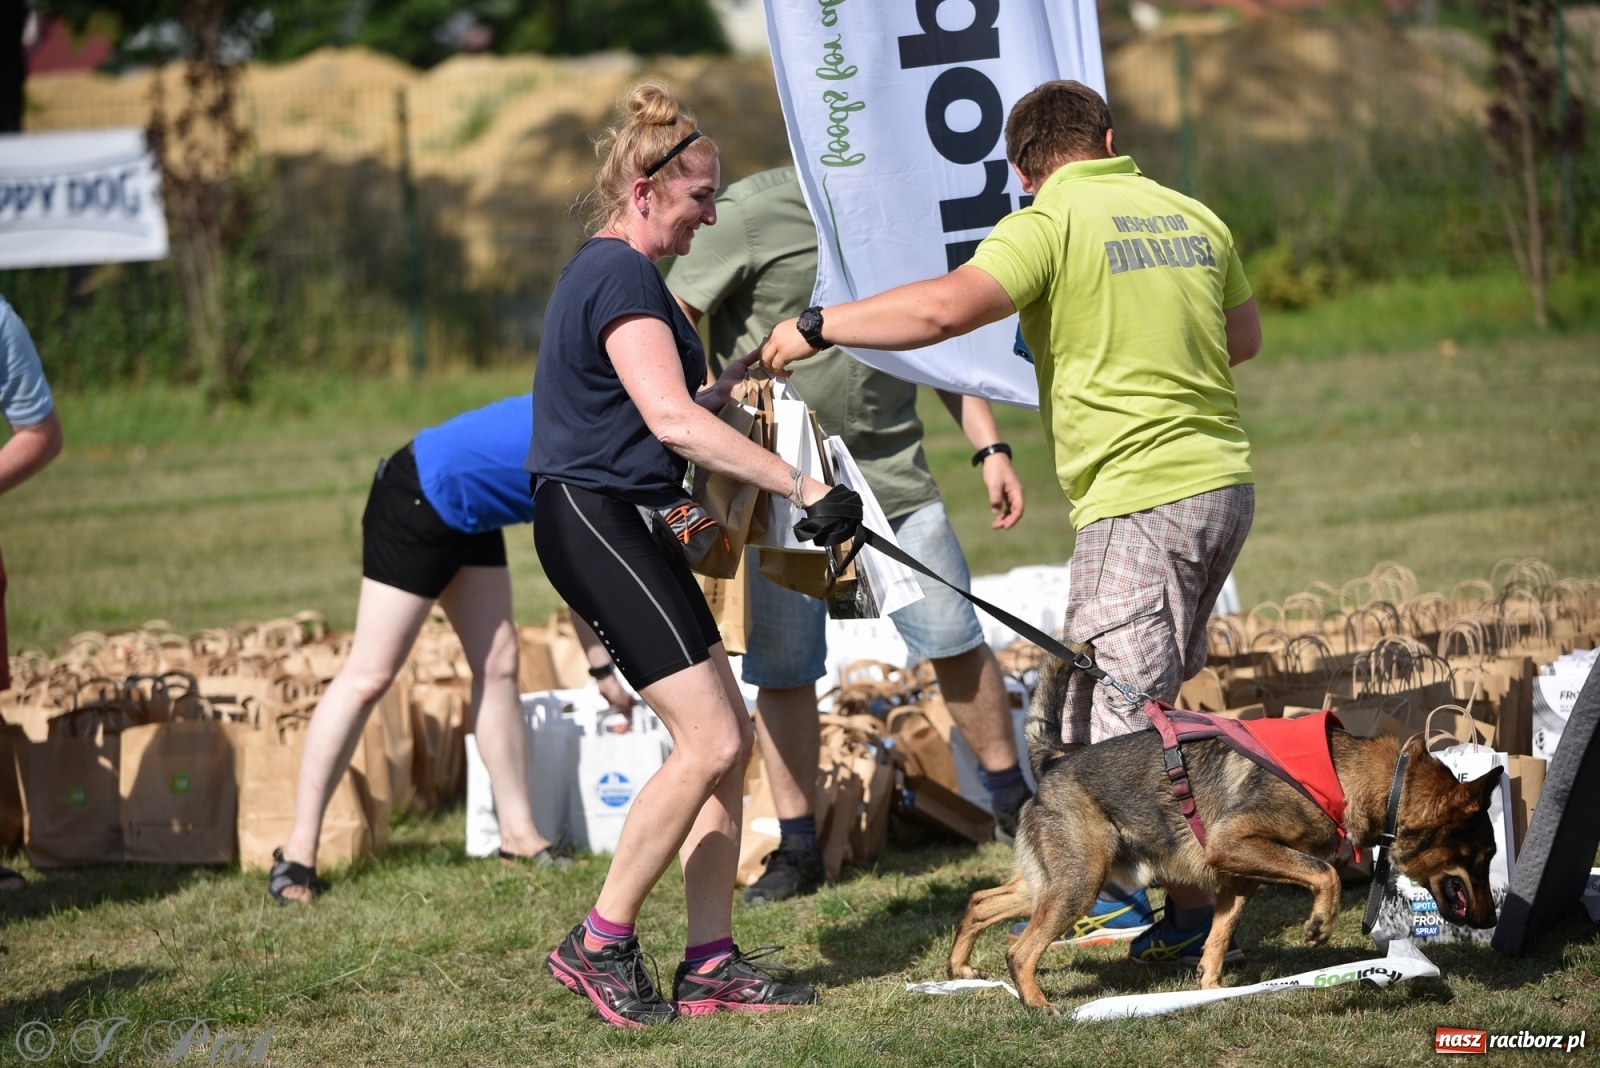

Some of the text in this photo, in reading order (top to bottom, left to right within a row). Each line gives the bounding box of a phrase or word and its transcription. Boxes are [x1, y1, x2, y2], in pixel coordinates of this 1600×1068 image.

[67, 170, 142, 216] DOG
[1111, 214, 1189, 234] INSPEKTOR
[1413, 902, 1430, 910] SPOT
[1415, 927, 1438, 935] SPRAY
